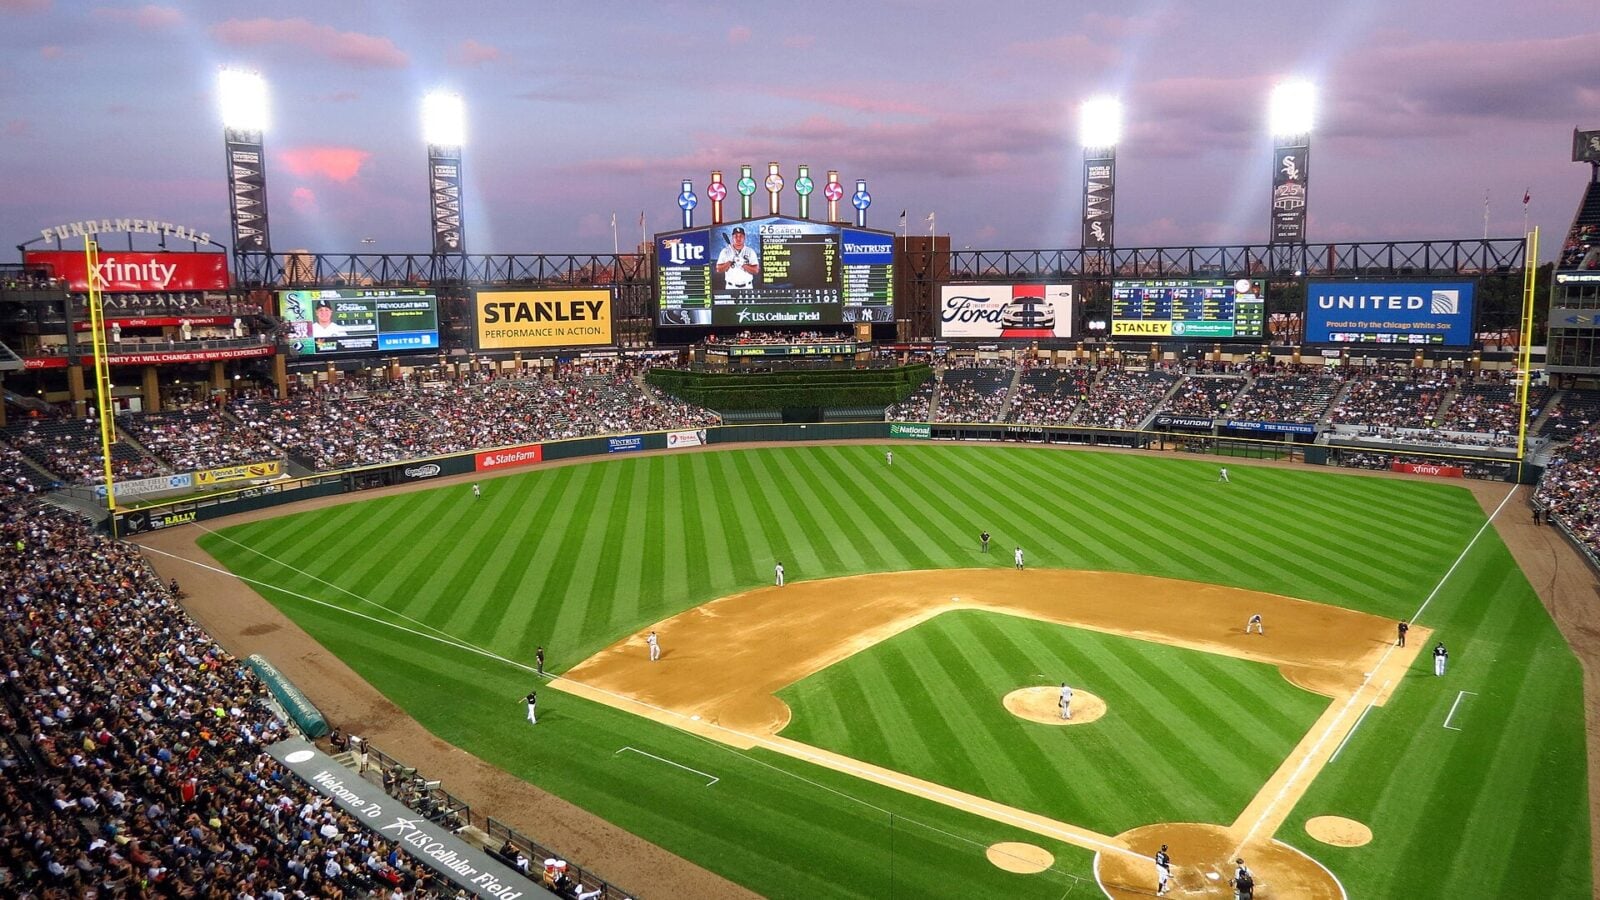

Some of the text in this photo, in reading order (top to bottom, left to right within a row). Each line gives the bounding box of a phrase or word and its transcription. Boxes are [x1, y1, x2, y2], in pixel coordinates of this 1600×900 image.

[42, 219, 210, 245] FUNDAMENTALS
[670, 242, 704, 264] Lite
[844, 244, 892, 252] WINTRUST
[90, 258, 176, 287] xfinity
[1319, 296, 1424, 309] UNITED
[484, 301, 604, 323] STANLEY
[765, 312, 798, 320] Cellular
[799, 312, 820, 320] Field
[942, 296, 1008, 323] Ford
[485, 328, 552, 338] PERFORMANCE
[567, 327, 601, 335] ACTION
[1115, 324, 1167, 332] STANLEY
[900, 426, 930, 434] National
[1413, 465, 1440, 475] xfinity
[164, 512, 196, 525] RALLY
[313, 771, 365, 806] Welcome
[361, 803, 381, 818] To
[424, 842, 478, 876] Cellular
[471, 872, 522, 900] Field
